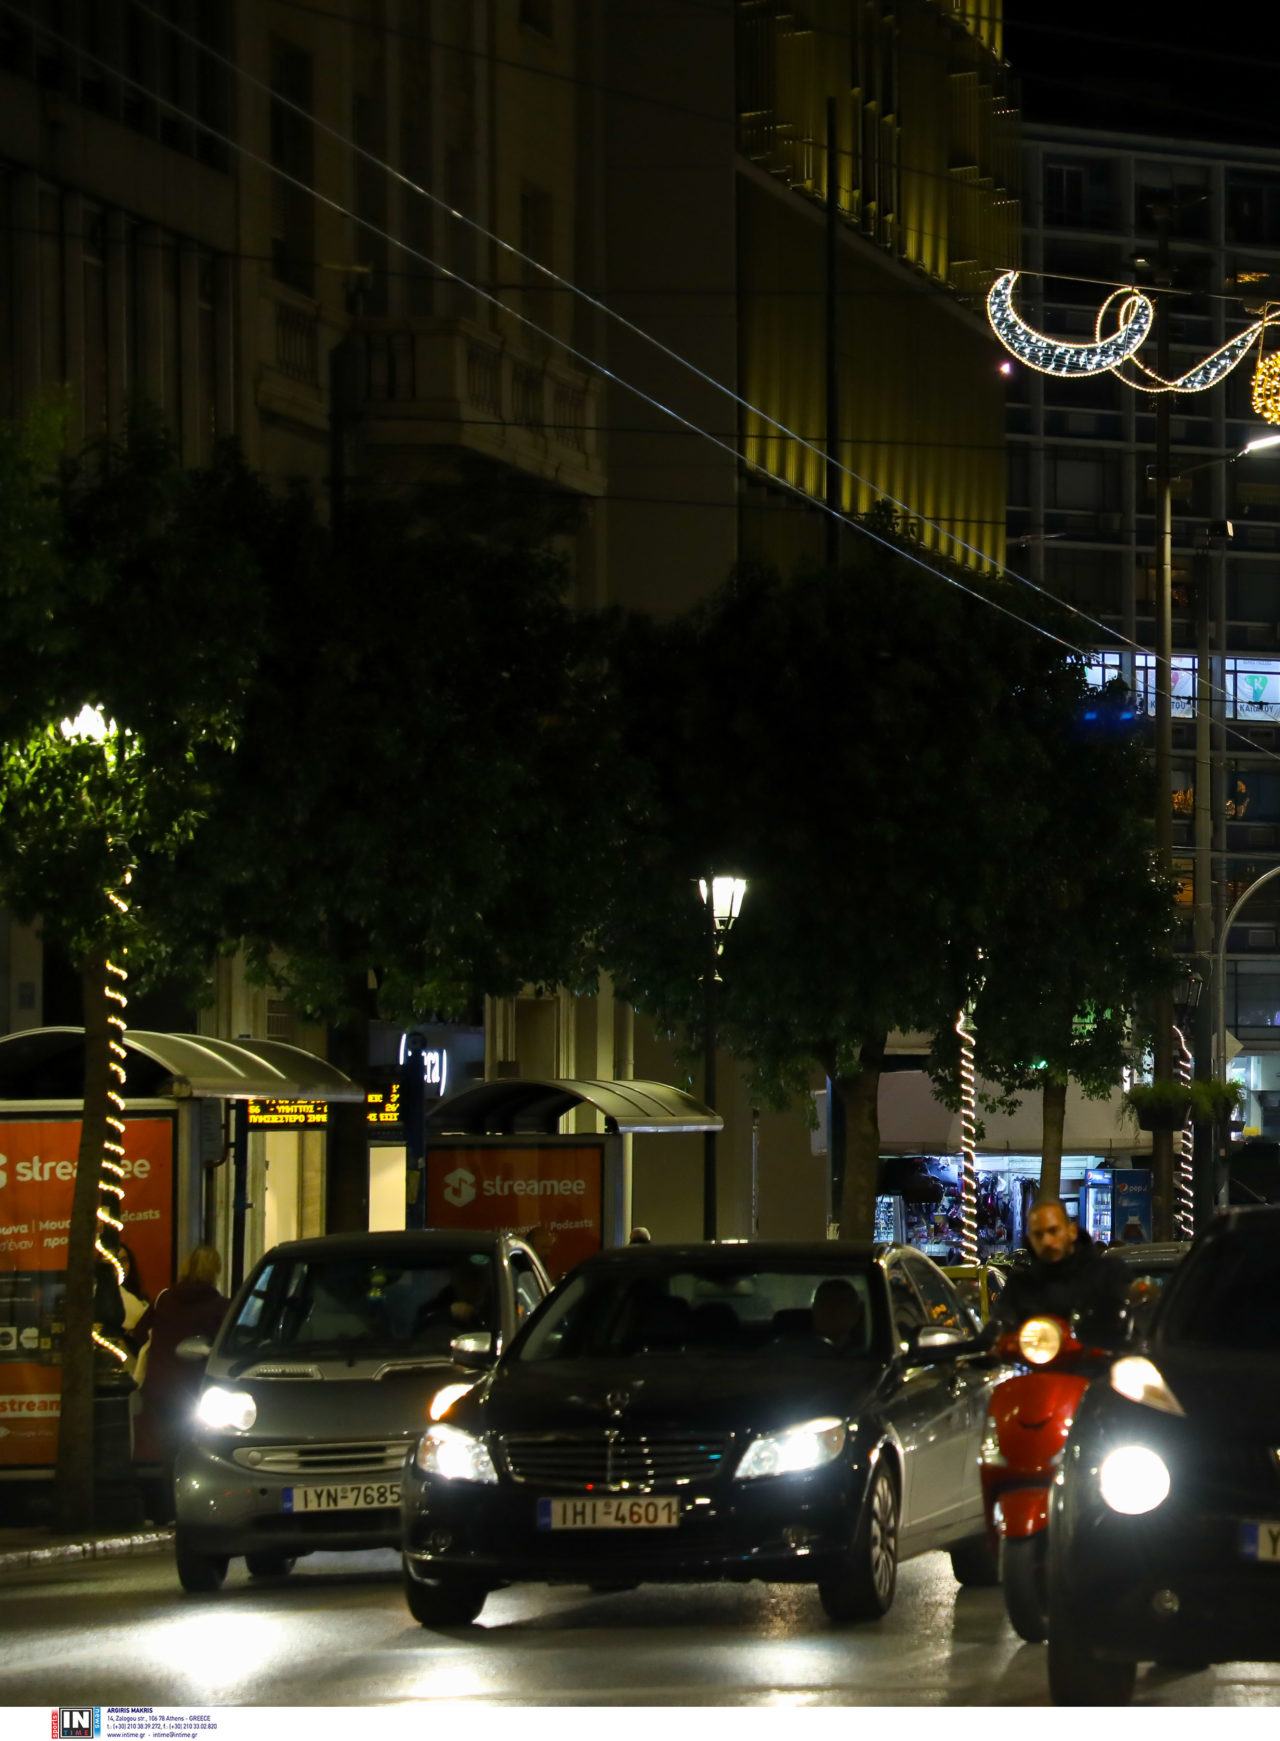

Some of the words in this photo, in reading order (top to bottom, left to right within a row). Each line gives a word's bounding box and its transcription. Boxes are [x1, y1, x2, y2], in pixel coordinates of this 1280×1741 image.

[1150, 702, 1186, 710] KTOU
[1239, 704, 1274, 713] ΚΑΠΑΟΥ
[15, 1155, 151, 1181] streee
[482, 1175, 586, 1196] streamee
[120, 1208, 161, 1223] dcasts
[550, 1218, 593, 1231] Podcasts
[0, 1398, 61, 1413] stream
[561, 1501, 674, 1525] IHI-4601
